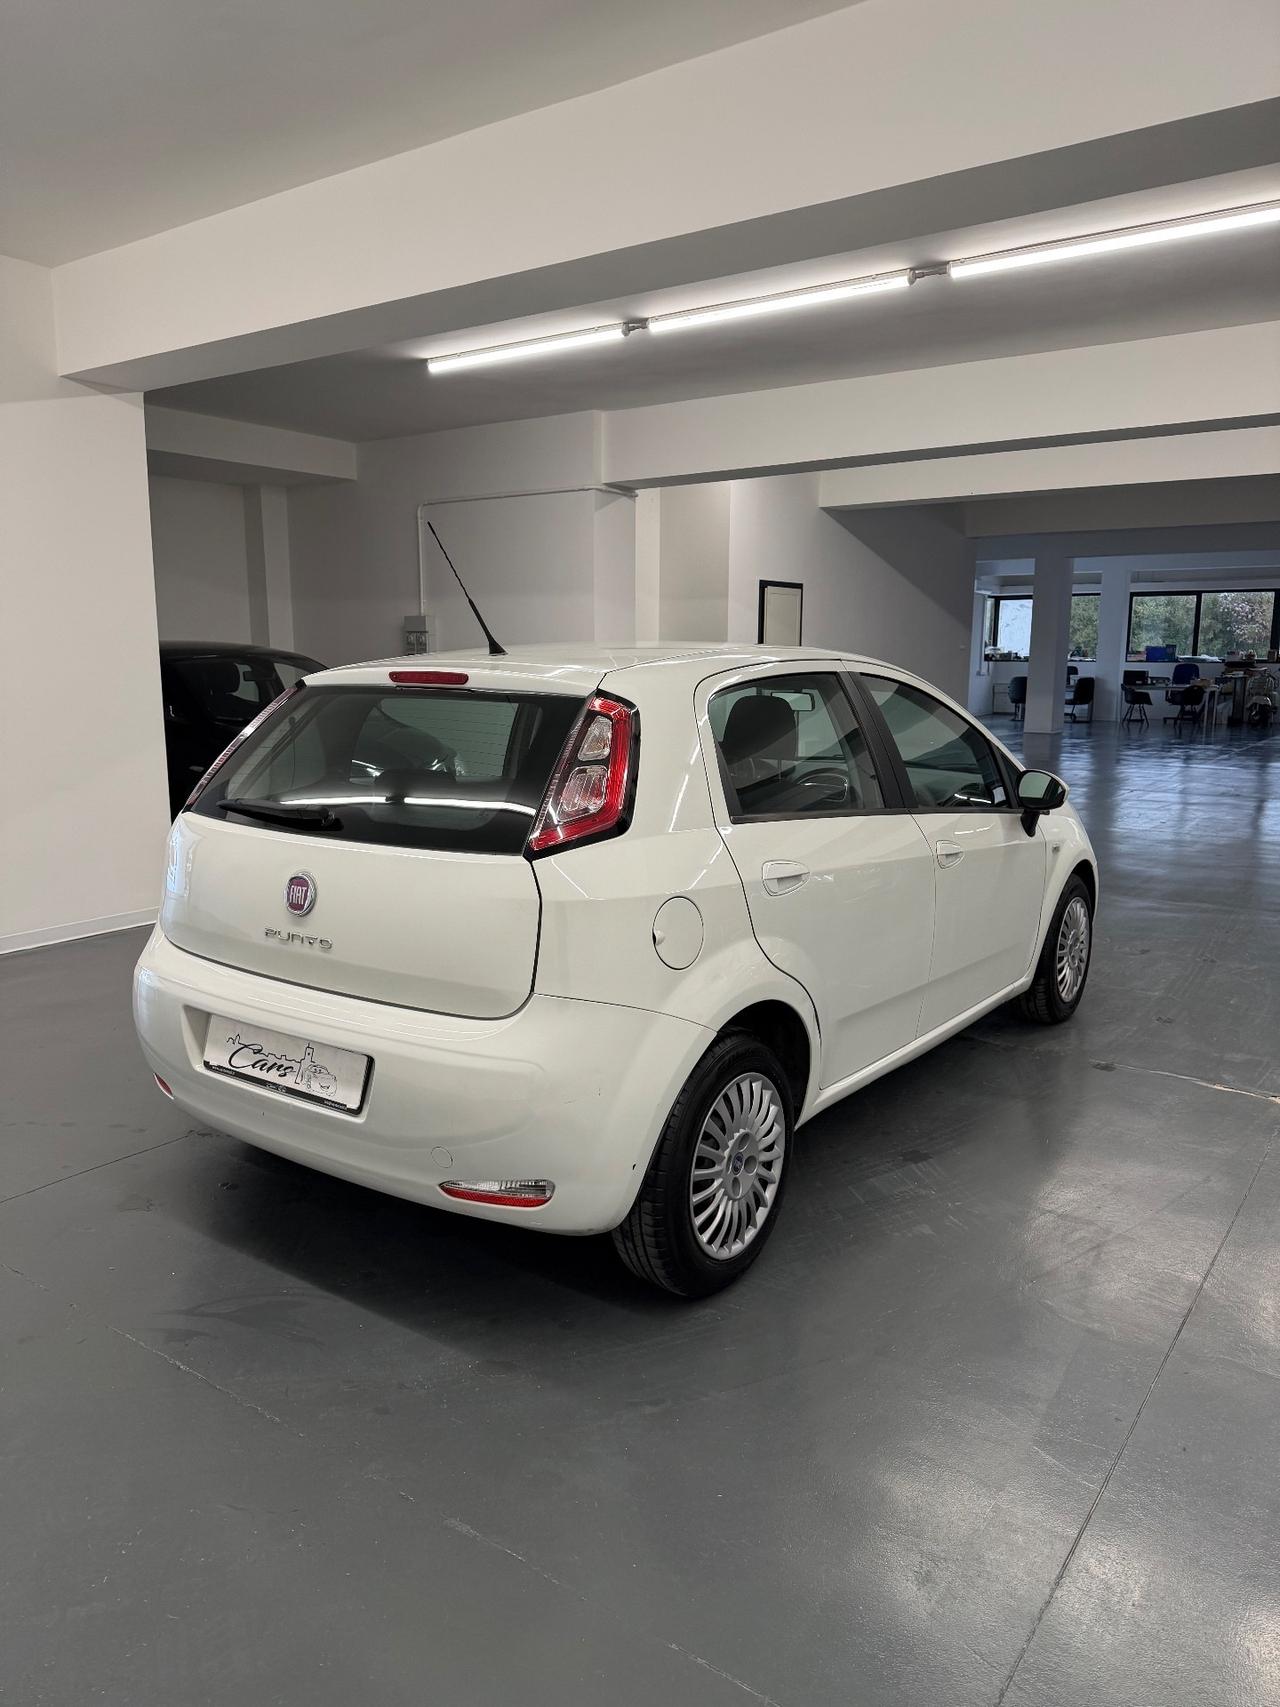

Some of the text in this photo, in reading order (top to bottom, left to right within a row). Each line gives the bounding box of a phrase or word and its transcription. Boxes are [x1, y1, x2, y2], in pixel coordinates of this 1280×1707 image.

[289, 885, 307, 905] FIAT
[264, 927, 333, 950] PUNTO
[228, 1043, 295, 1078] Cars
